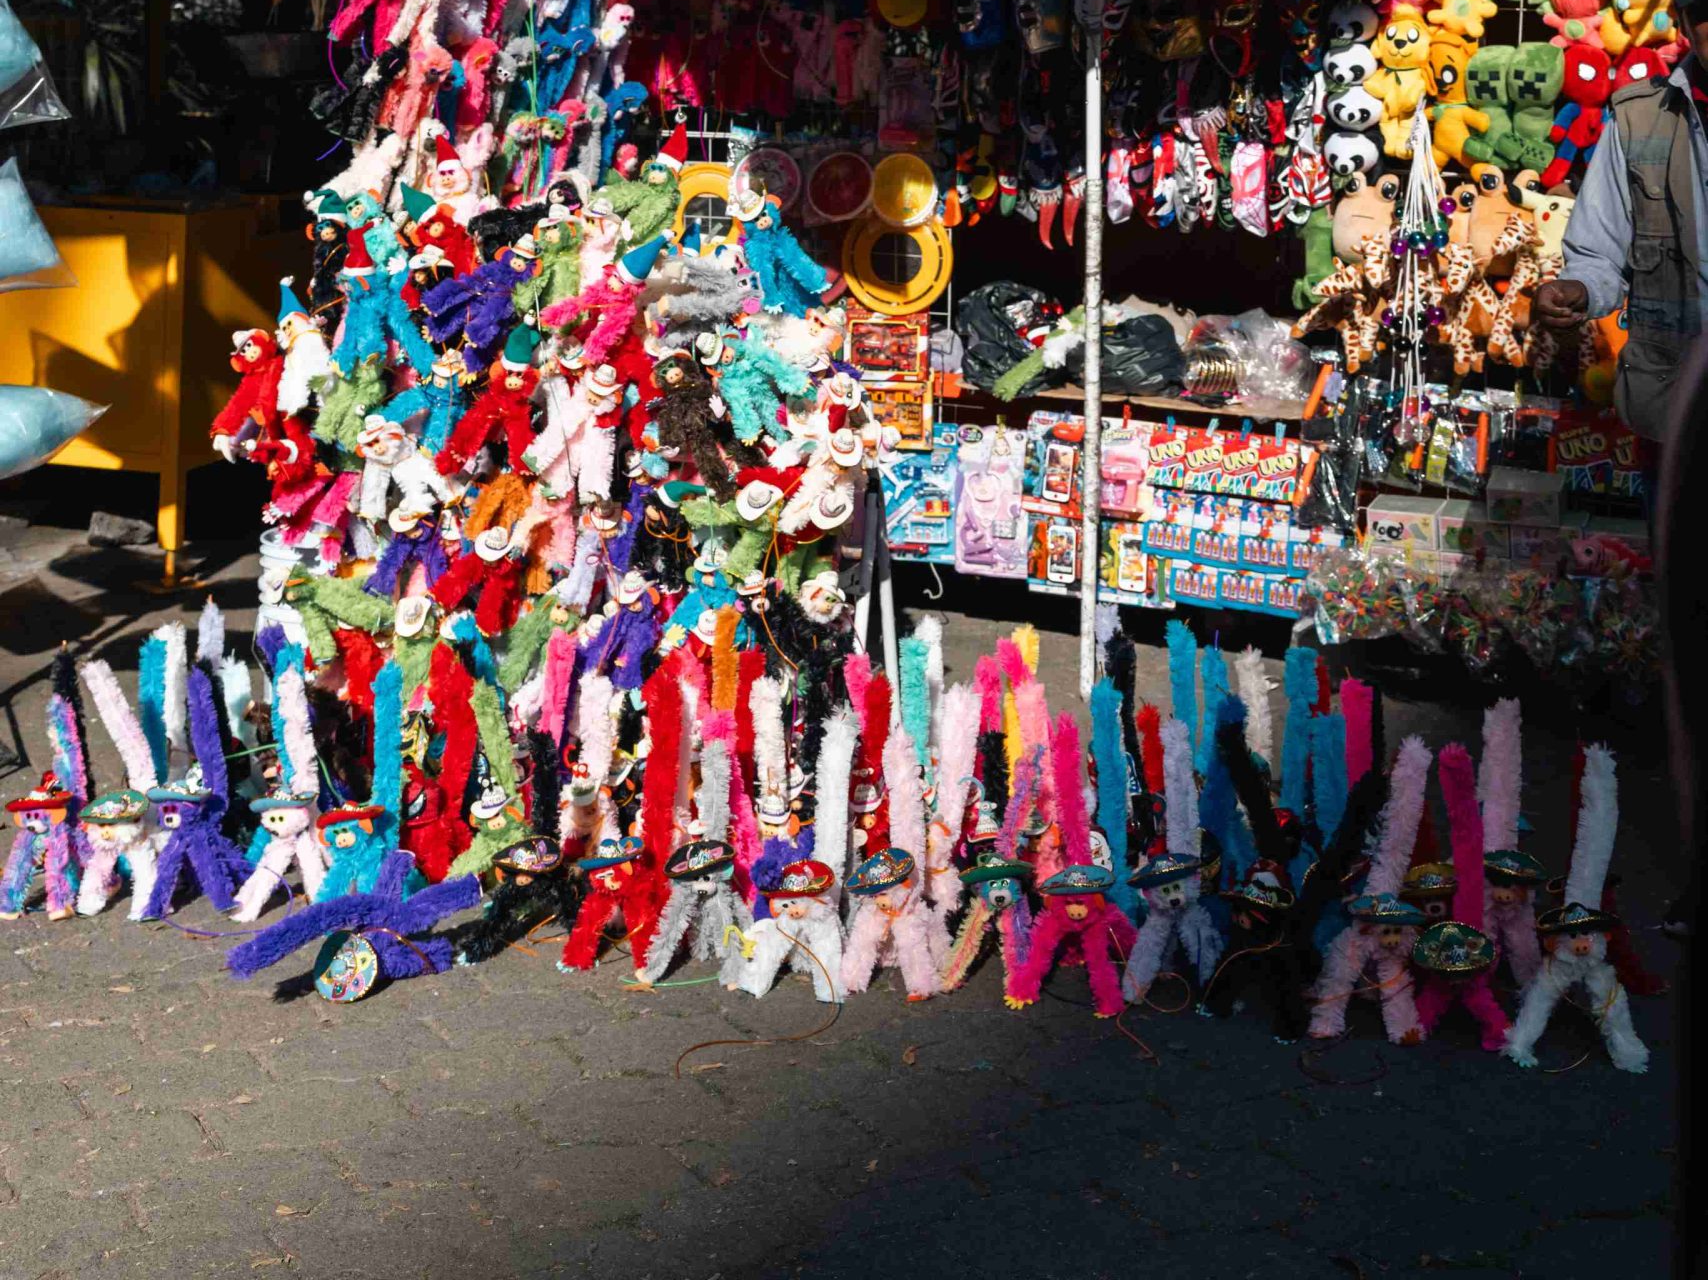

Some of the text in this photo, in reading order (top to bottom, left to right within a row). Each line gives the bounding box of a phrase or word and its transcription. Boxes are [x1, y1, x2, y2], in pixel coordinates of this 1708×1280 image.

[1150, 439, 1186, 463] UNO
[1185, 445, 1223, 469] UNO
[1557, 433, 1607, 461] UNO
[1222, 448, 1259, 472] UNO
[1258, 453, 1298, 477] UNO
